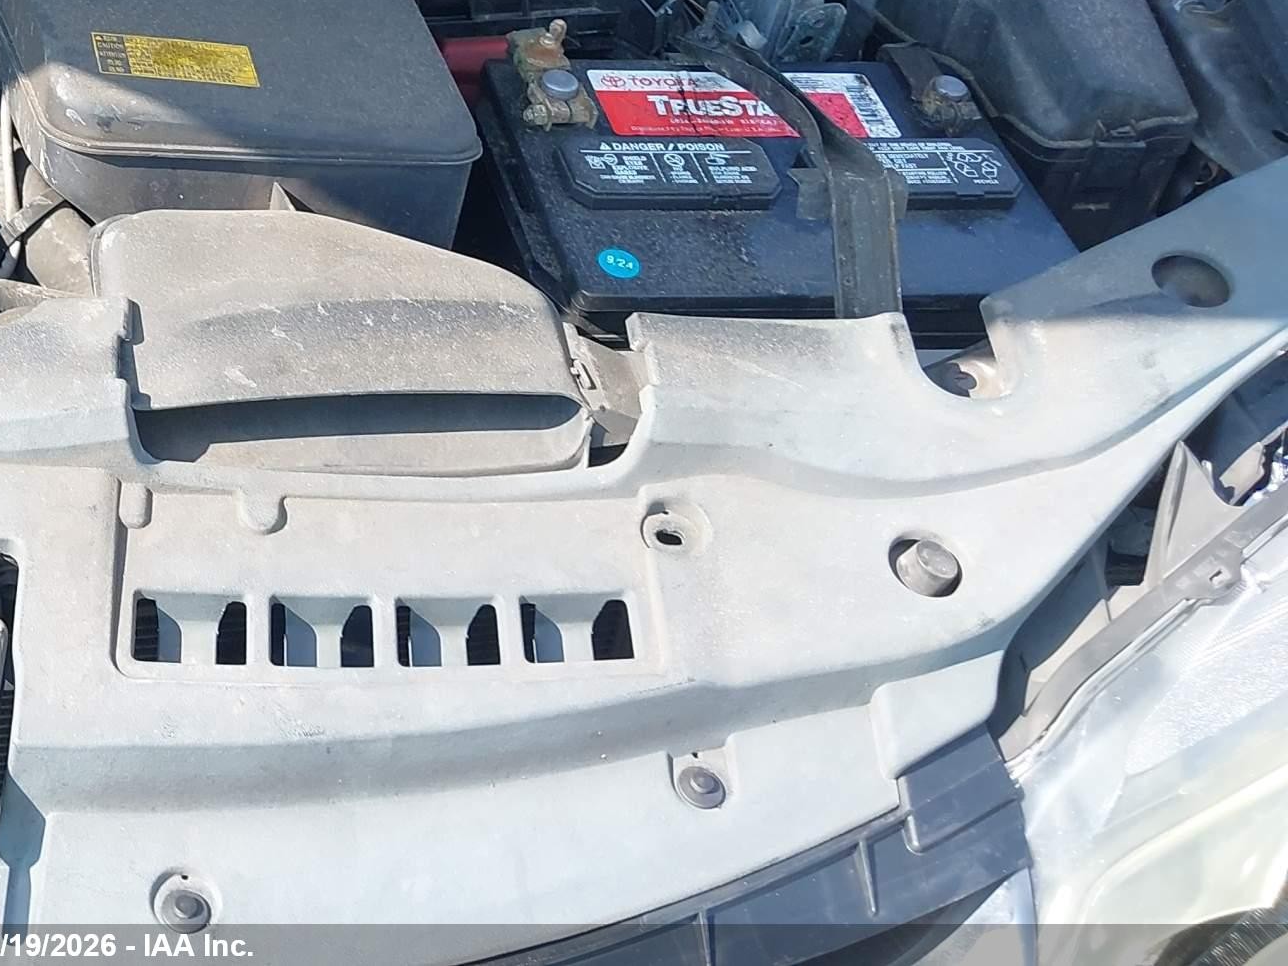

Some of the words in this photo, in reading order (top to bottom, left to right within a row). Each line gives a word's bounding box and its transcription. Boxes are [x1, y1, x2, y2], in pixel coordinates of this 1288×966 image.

[628, 77, 698, 87] TOYOTA
[612, 142, 666, 151] DANGER
[678, 143, 726, 151] POISON
